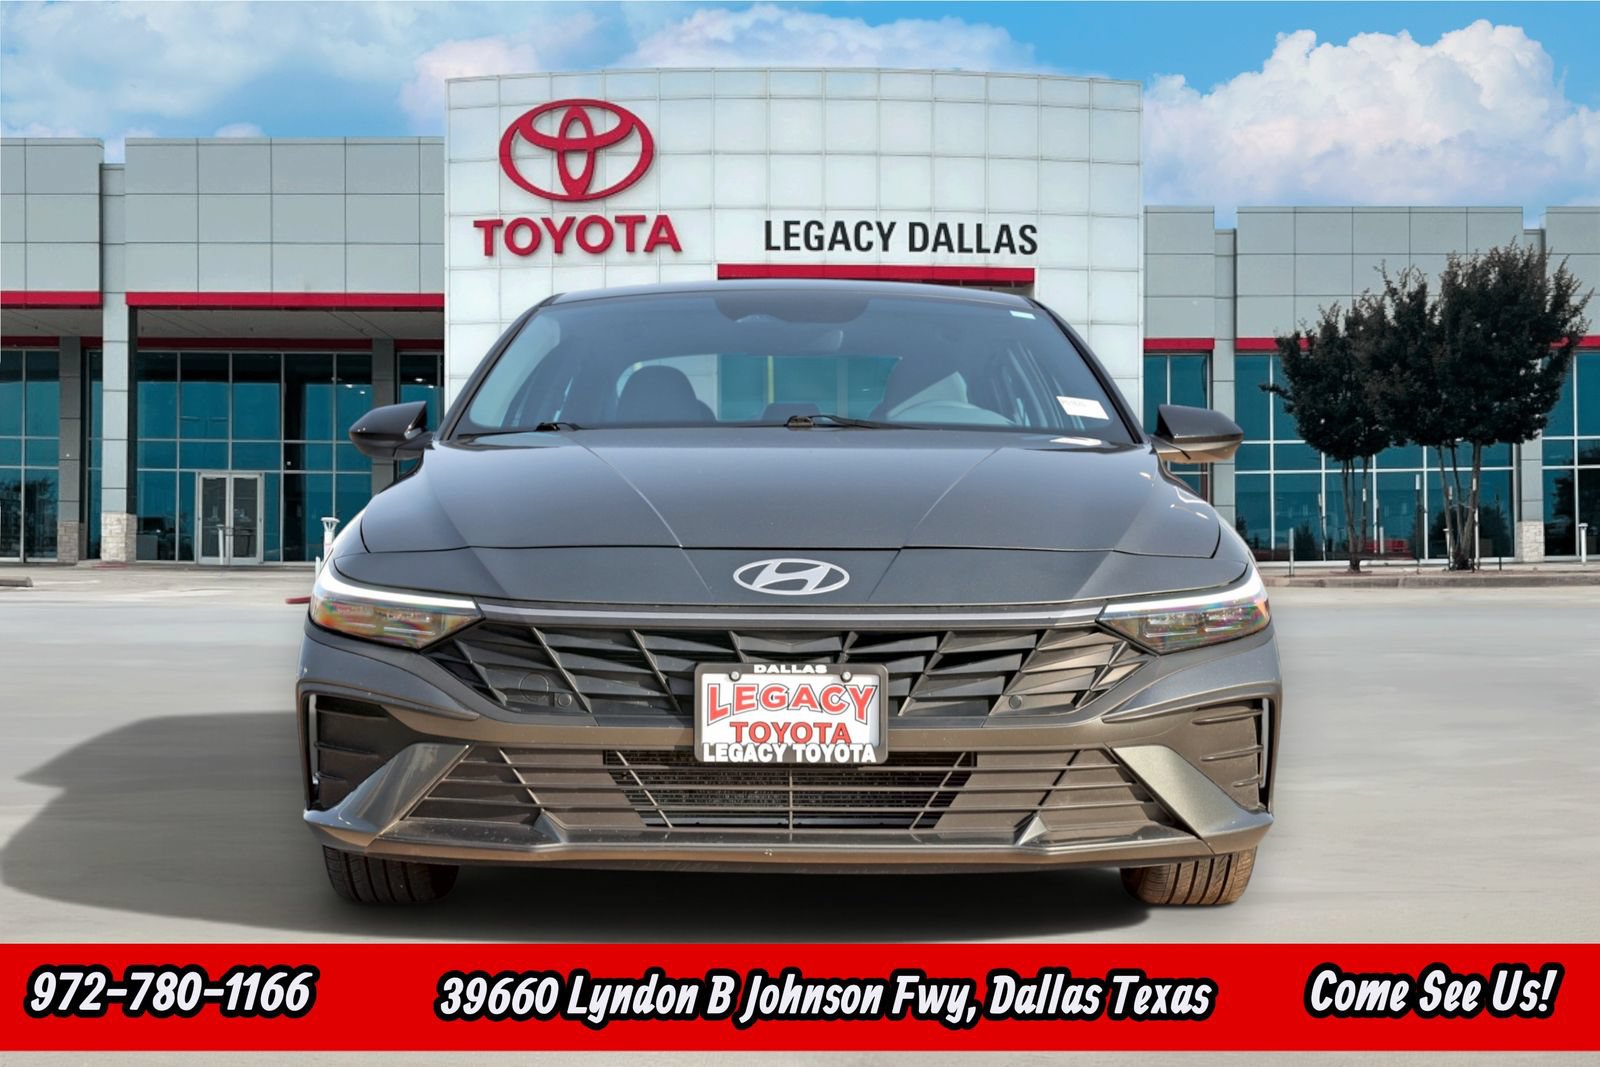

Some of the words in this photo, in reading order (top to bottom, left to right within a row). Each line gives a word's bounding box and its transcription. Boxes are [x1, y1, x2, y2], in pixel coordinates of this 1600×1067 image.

[473, 215, 683, 257] TOYOTA
[765, 220, 897, 252] LEGACY
[908, 221, 1038, 255] DALLAS
[753, 664, 828, 674] DALLAS
[707, 683, 877, 726] LEGACY
[729, 721, 852, 744] TOYOTA
[703, 743, 787, 763] LEGACY
[793, 743, 877, 763] TOYOTA
